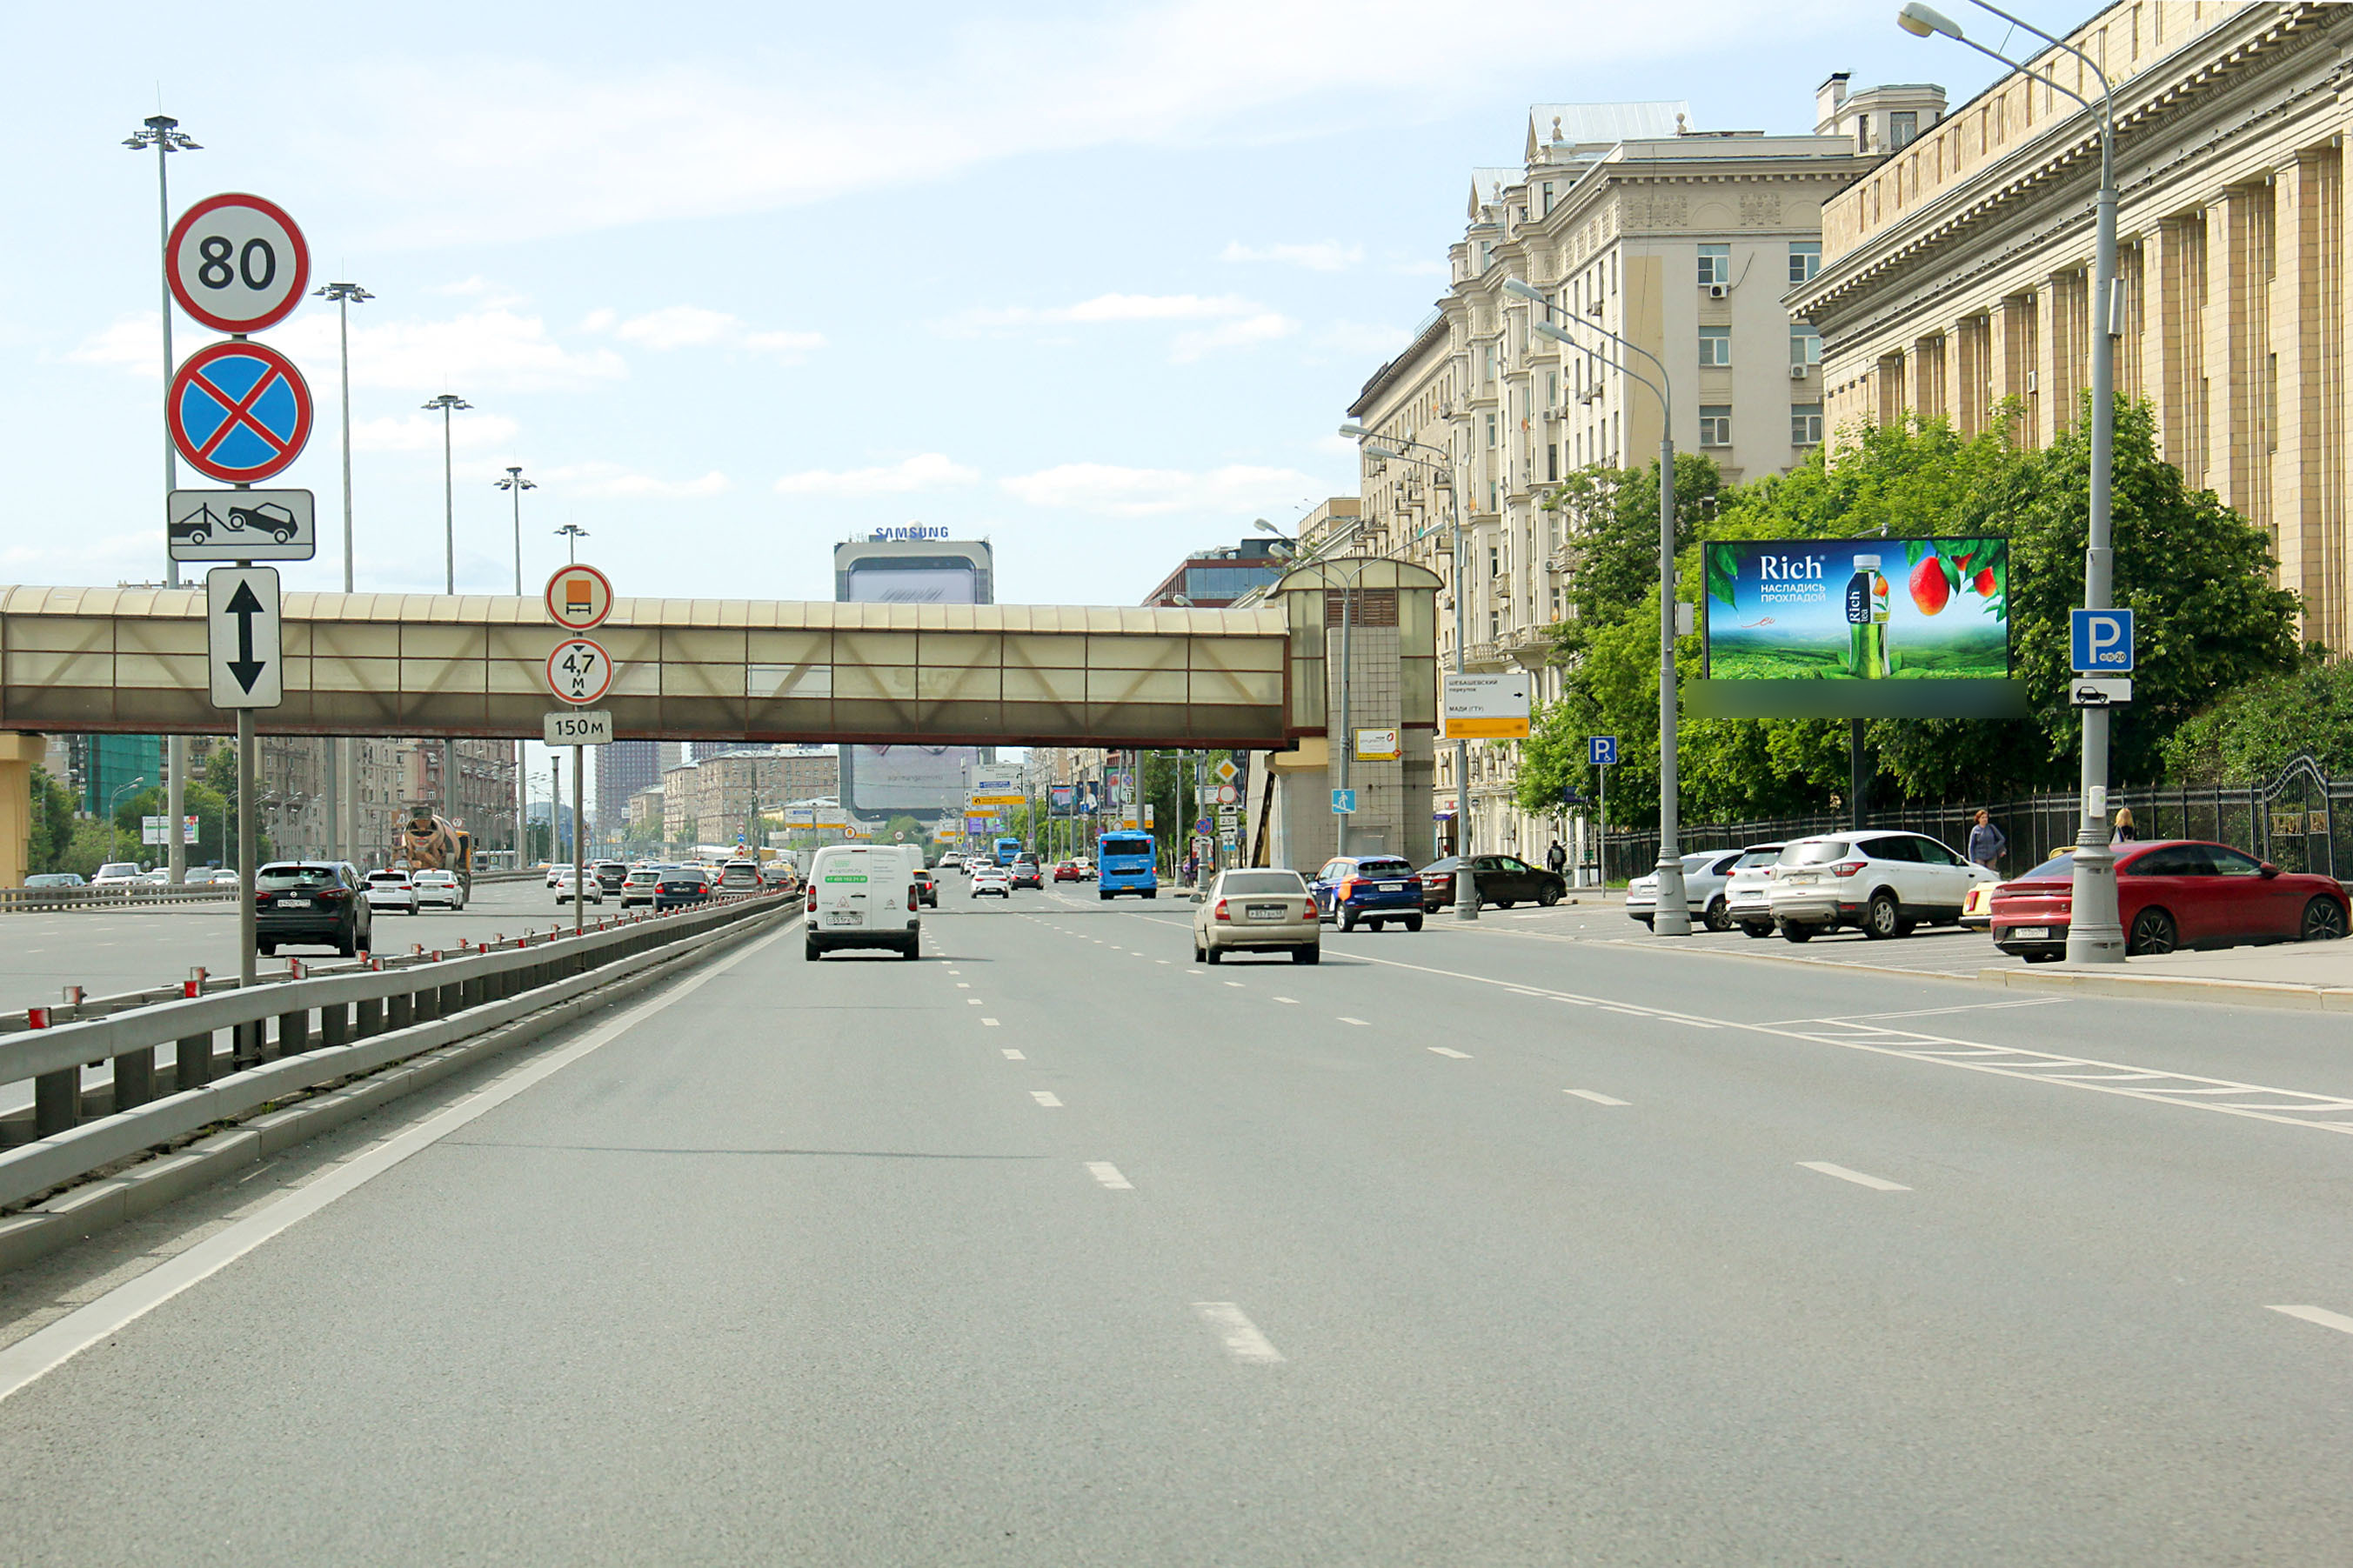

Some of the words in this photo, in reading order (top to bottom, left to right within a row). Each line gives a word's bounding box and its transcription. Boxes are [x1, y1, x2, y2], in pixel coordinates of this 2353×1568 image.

[198, 235, 276, 291] 80
[875, 526, 949, 538] SAMSUNG
[1760, 554, 1823, 580] Rich
[1761, 583, 1826, 593] НАСЛАДИСЬ
[1761, 592, 1827, 604] ПРОХЛАДОЙ
[1849, 591, 1861, 623] Rich
[2089, 617, 2121, 664] P
[562, 654, 596, 677] 4,7
[1595, 739, 1610, 761] P
